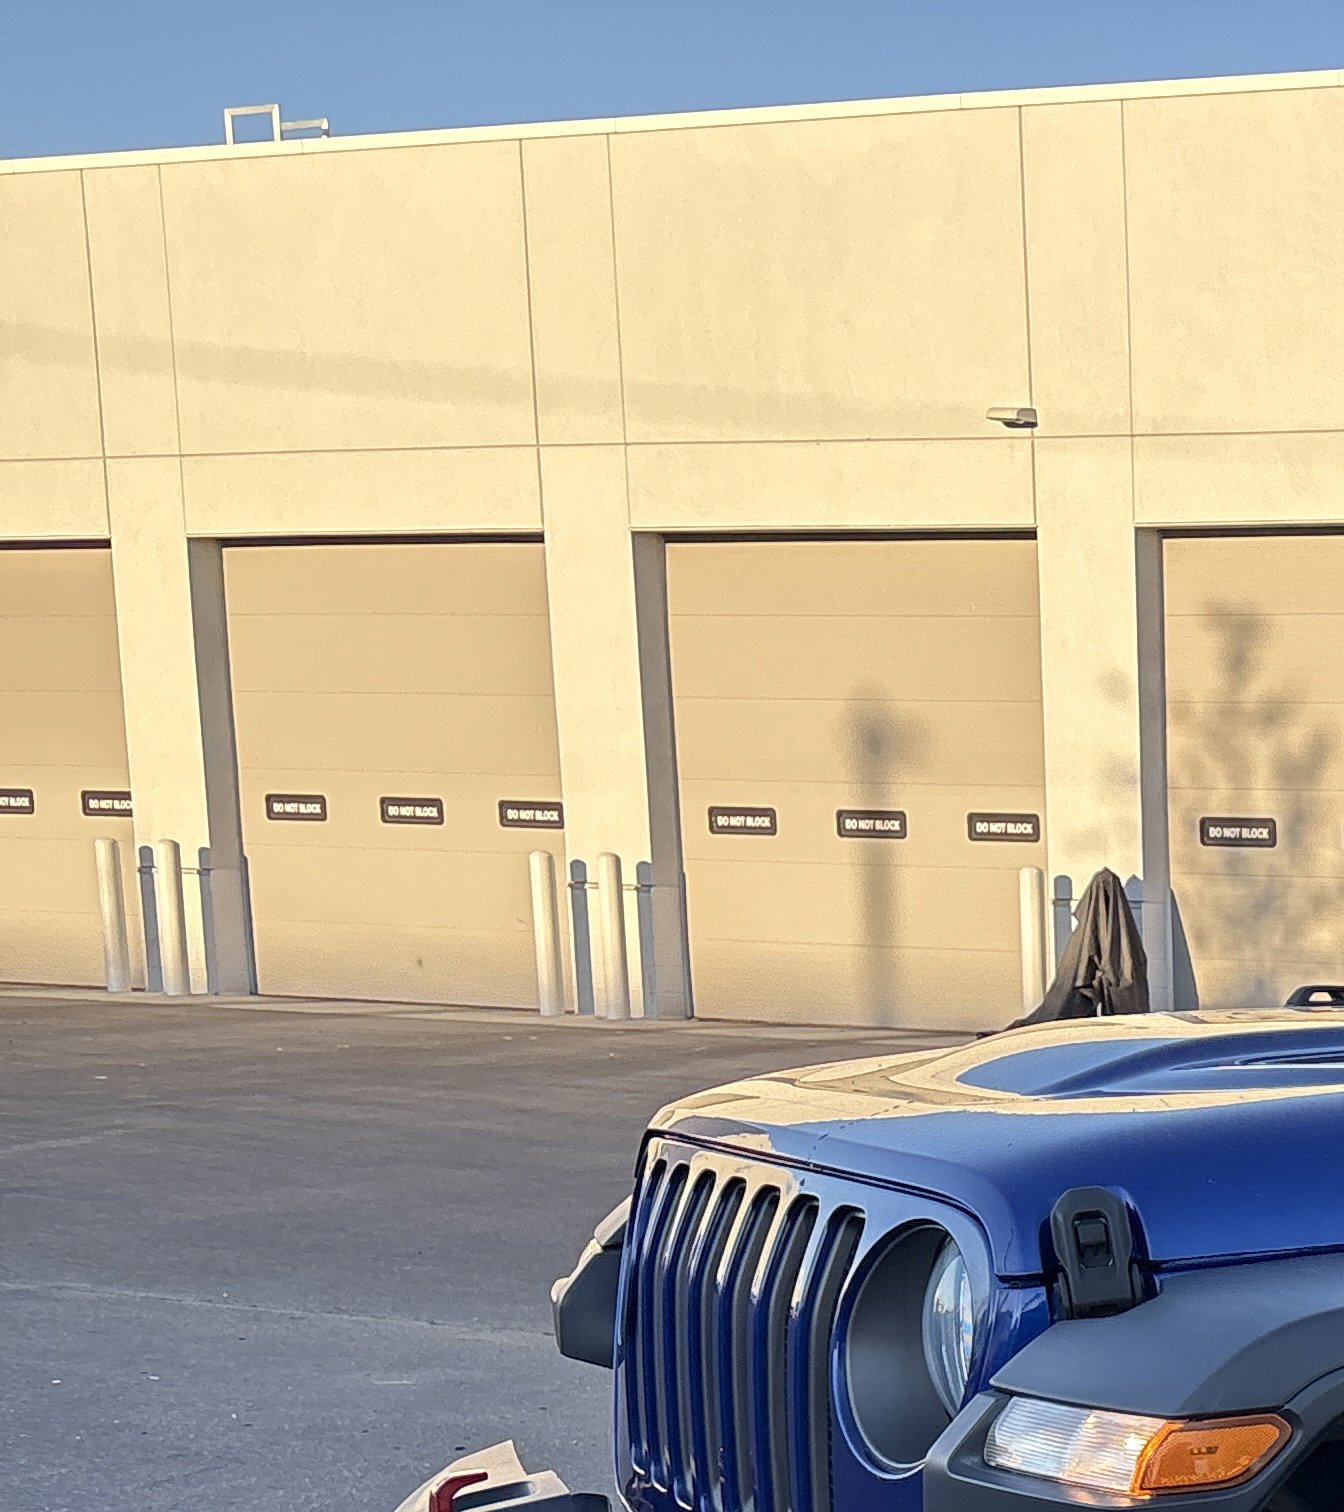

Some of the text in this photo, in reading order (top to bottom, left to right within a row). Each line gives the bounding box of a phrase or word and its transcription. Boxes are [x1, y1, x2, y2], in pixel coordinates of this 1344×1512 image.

[113, 799, 132, 810] BLOC
[272, 802, 322, 814] DO NOT BLOCK
[387, 805, 439, 818] DO NOT BLOCK
[506, 808, 560, 821] DO NOT BLOCK
[716, 815, 771, 828] DO NOT BLOCK
[844, 818, 901, 831] DO NOT BLOCK
[975, 821, 1034, 834] DO NOT BLOCK
[1208, 826, 1270, 839] DO NOT BLOCK
